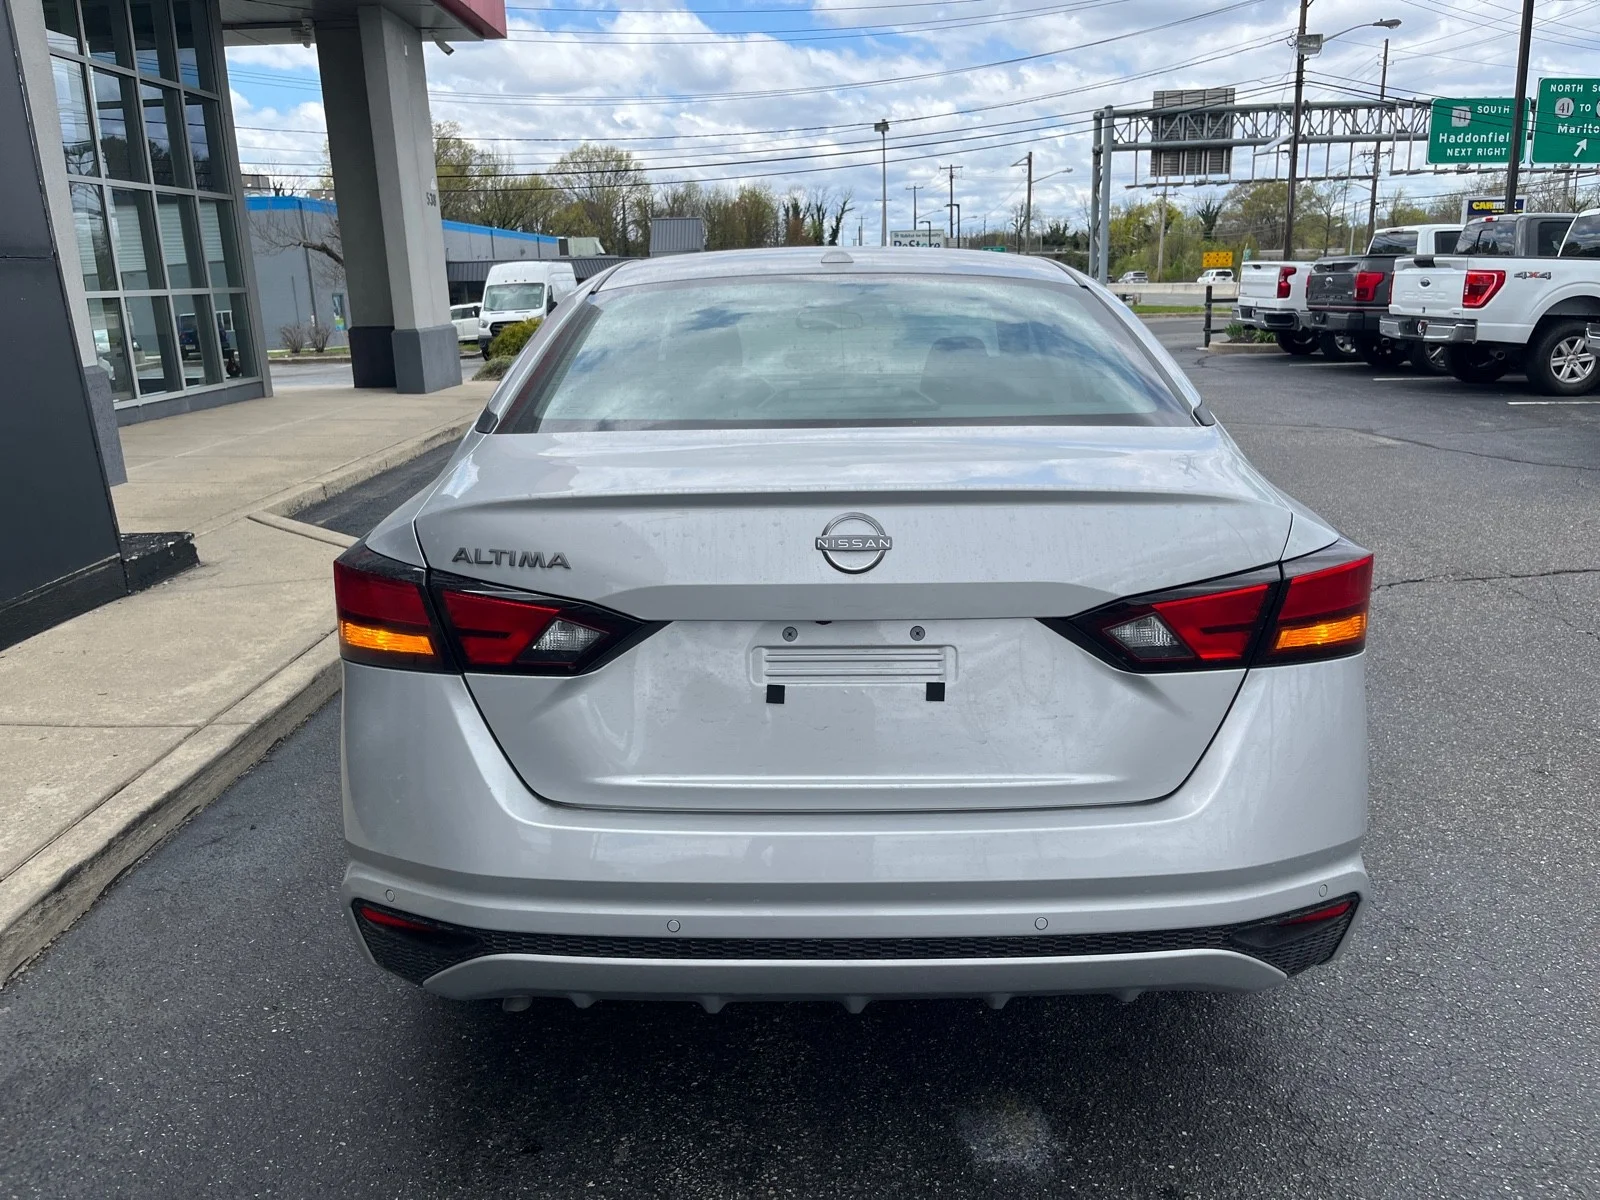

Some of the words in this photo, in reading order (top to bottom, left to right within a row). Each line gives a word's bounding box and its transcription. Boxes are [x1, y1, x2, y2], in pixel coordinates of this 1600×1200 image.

[1550, 84, 1584, 92] NORTH
[1477, 105, 1510, 114] SOUTH
[1559, 102, 1570, 113] 41
[1579, 103, 1591, 112] TO
[1439, 131, 1512, 143] Haddonfiel
[1446, 147, 1472, 156] NEXT
[1476, 147, 1507, 156] RIGHT
[817, 539, 891, 548] NISSAN
[451, 547, 571, 569] ALTIMA
